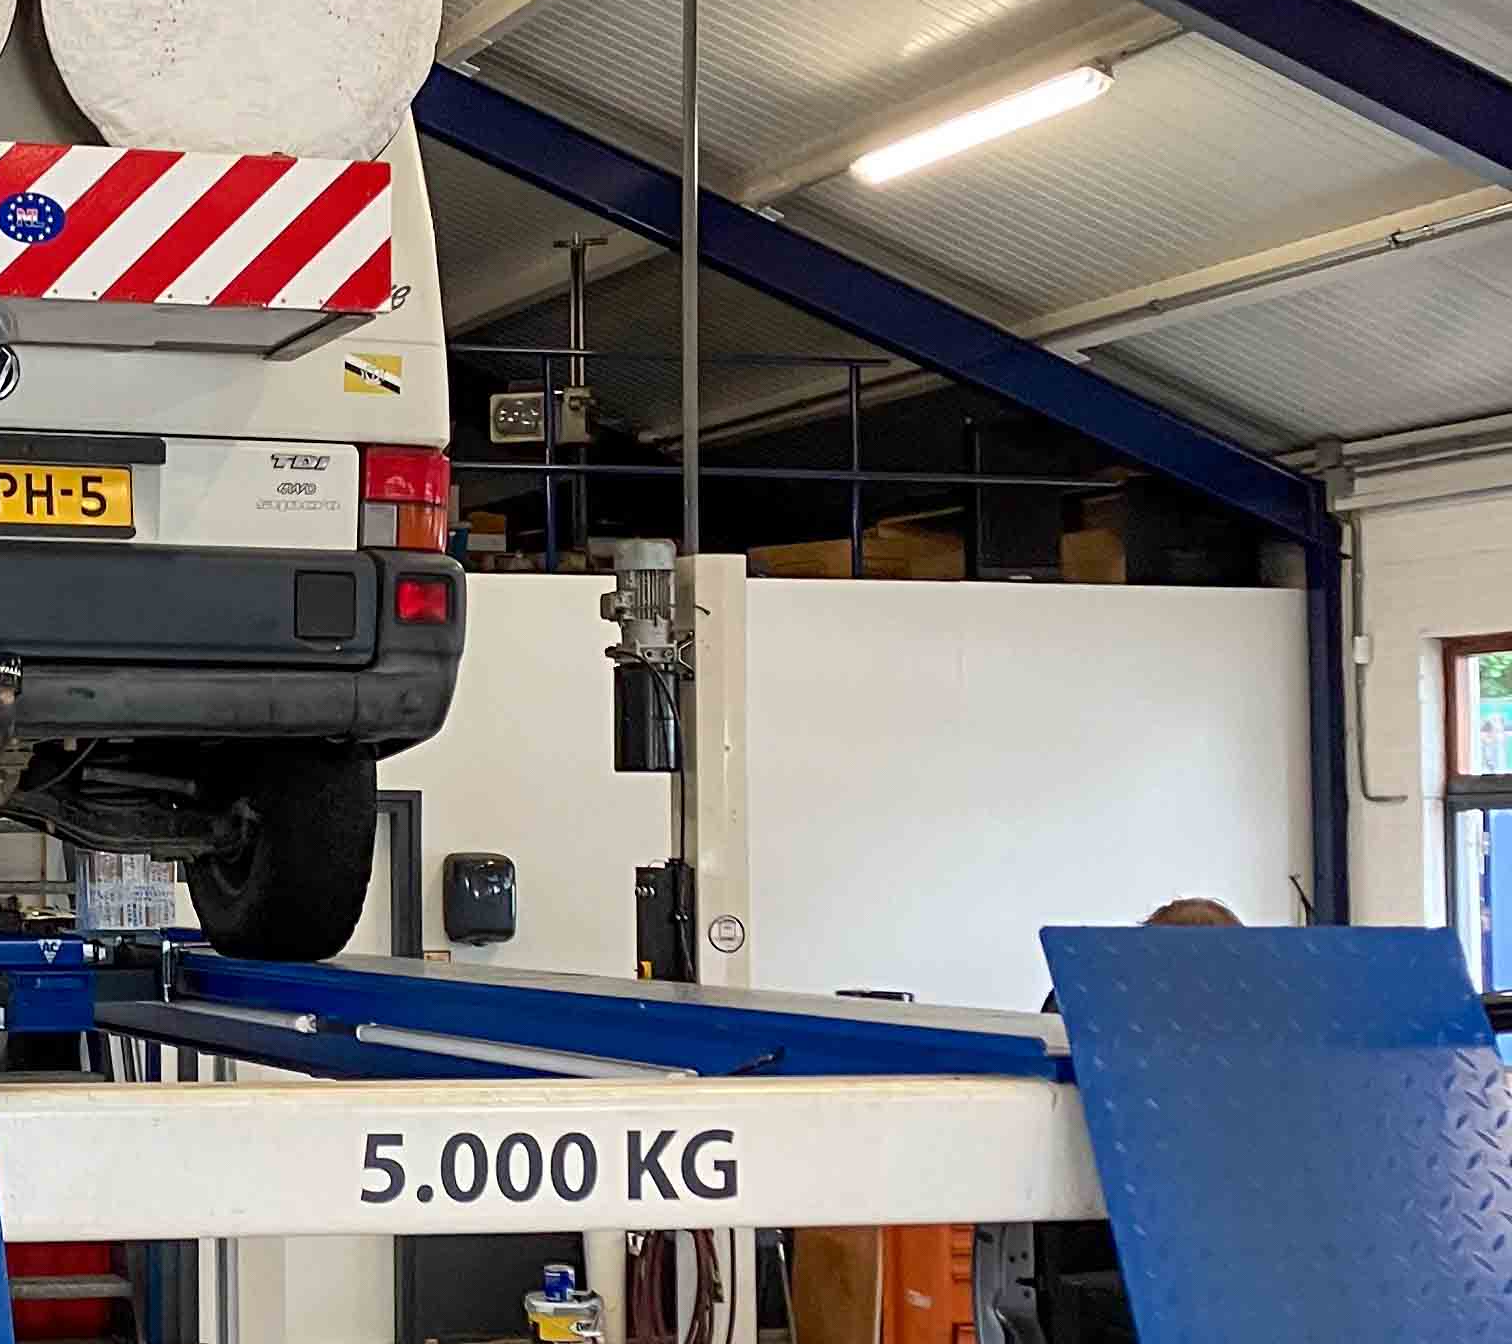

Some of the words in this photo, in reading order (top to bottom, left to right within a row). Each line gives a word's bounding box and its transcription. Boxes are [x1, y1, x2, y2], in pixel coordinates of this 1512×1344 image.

[15, 207, 45, 228] NL
[360, 1131, 598, 1204] 5.000
[626, 1128, 740, 1201] KG
